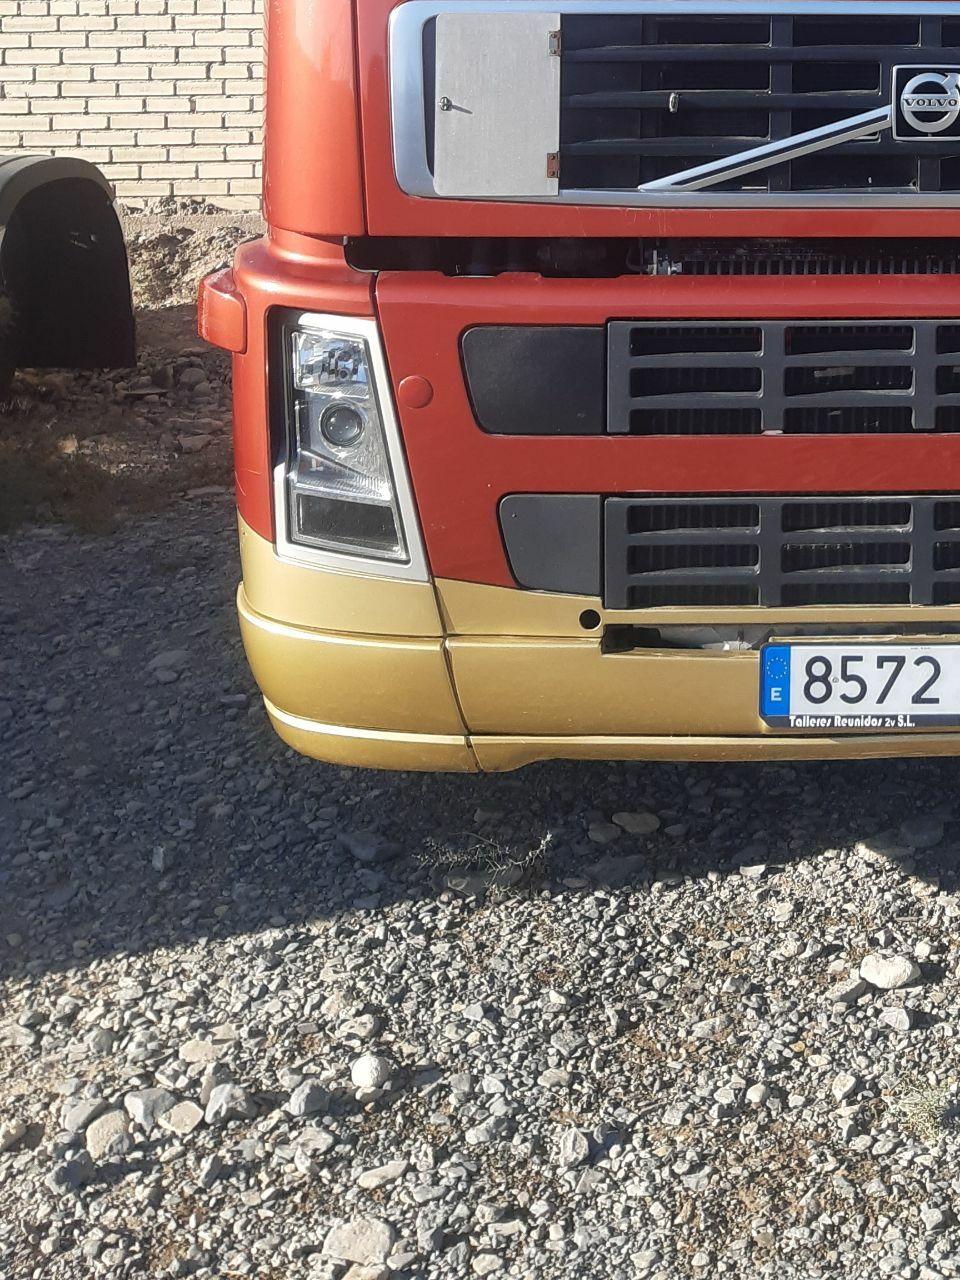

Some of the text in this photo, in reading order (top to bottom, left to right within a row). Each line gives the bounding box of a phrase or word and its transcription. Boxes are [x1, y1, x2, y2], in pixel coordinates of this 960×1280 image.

[903, 98, 958, 107] VOLVO
[803, 655, 942, 705] 8572
[770, 688, 782, 701] E
[789, 715, 831, 727] Talleres
[834, 715, 881, 727] Reunidos
[897, 715, 915, 726] S.L.
